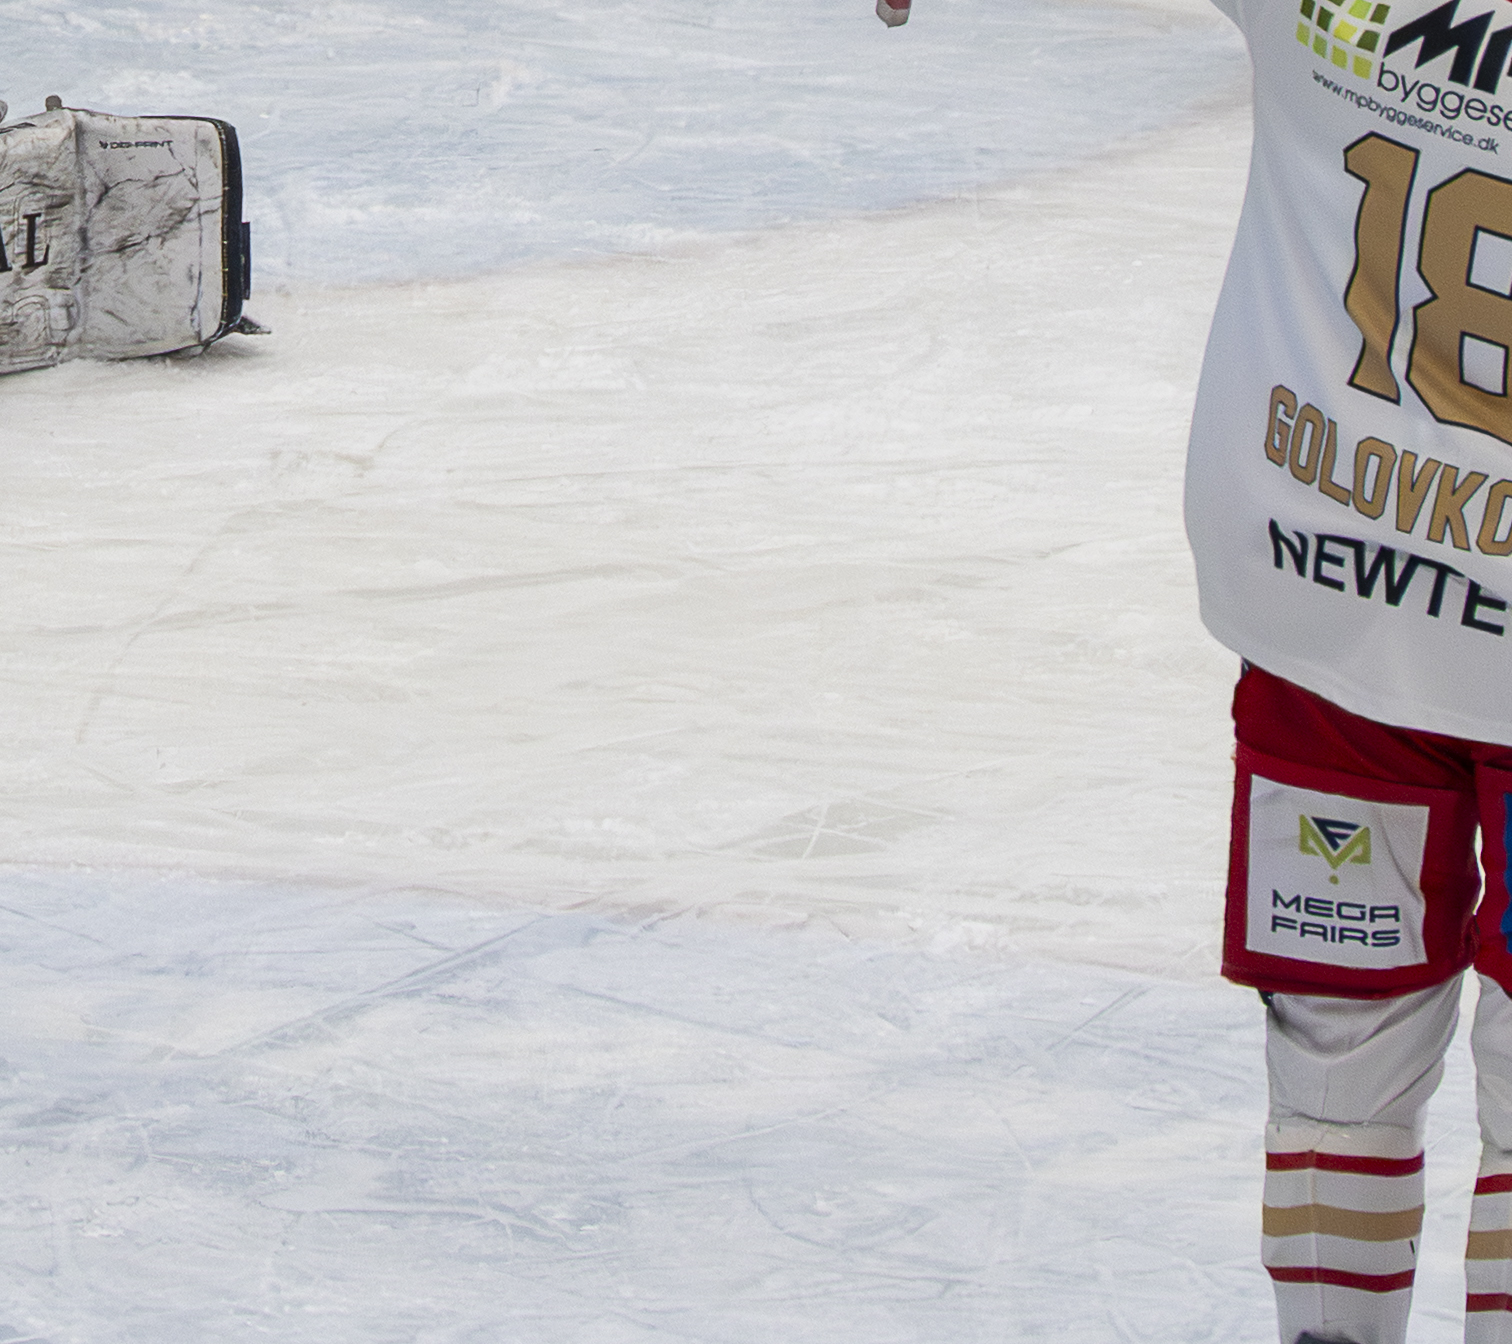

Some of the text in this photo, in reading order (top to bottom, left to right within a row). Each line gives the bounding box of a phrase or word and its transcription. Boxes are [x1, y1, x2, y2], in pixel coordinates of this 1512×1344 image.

[1311, 70, 1500, 156] www.mpbyggeservice.dk
[1271, 889, 1401, 924] MEGA
[1270, 916, 1401, 947] FAIRS
